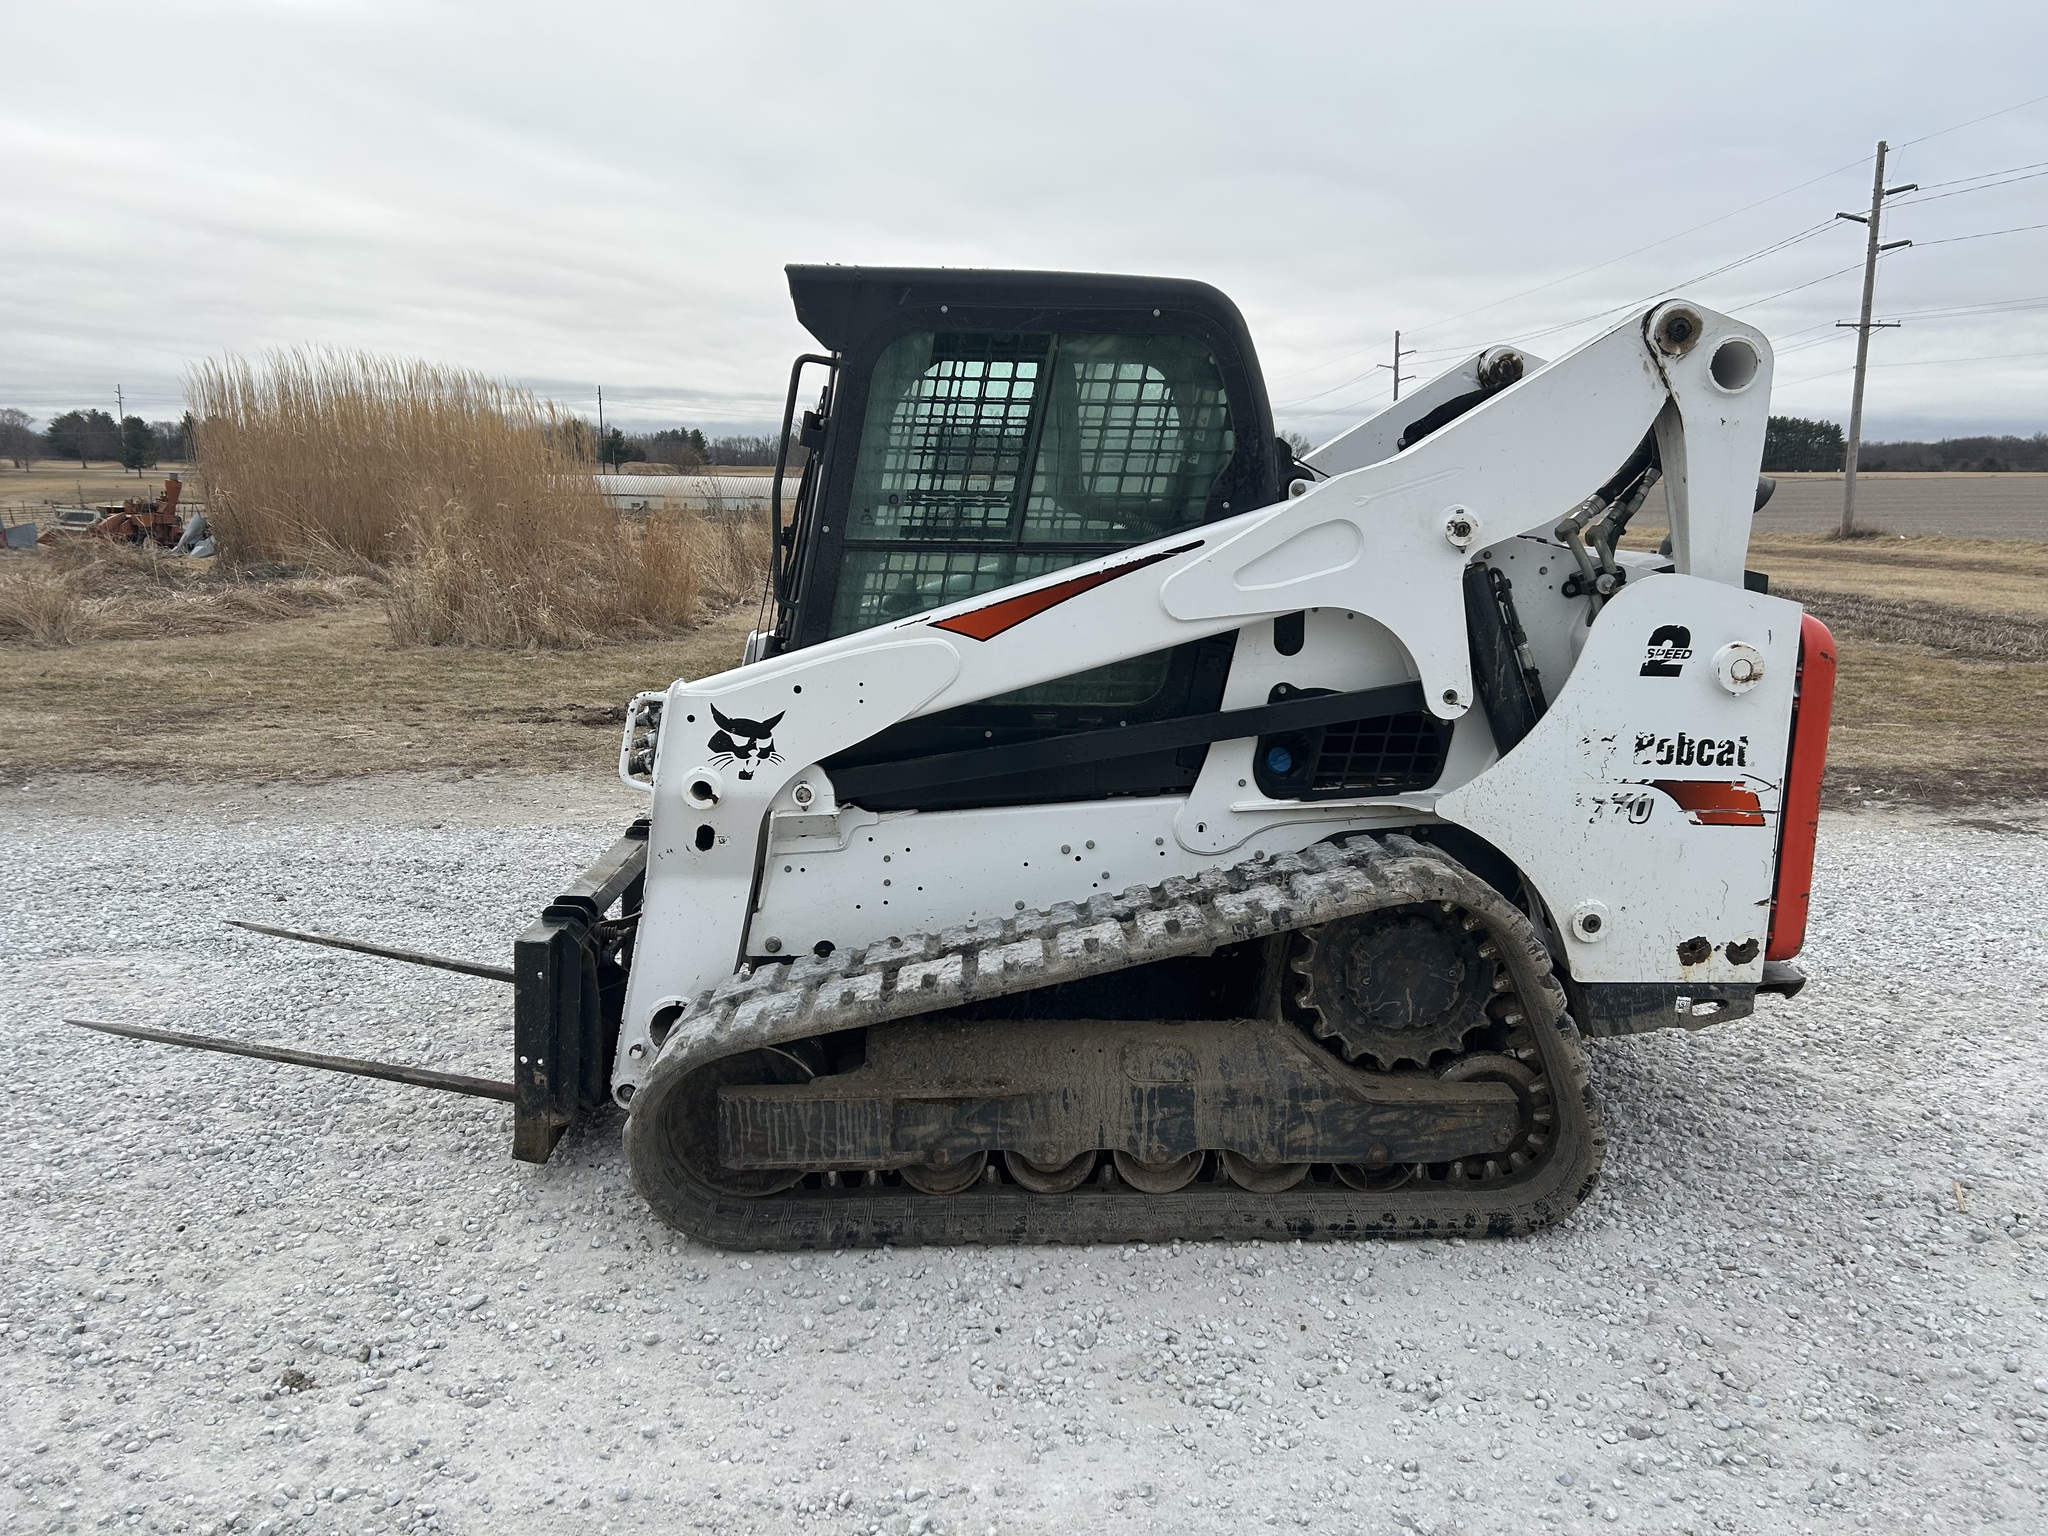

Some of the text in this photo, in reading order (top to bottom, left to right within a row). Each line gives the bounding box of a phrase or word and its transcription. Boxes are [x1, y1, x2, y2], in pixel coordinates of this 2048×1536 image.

[1639, 625, 1691, 677] 2
[1647, 648, 1693, 660] SPEED
[1633, 732, 1749, 767] Bobcat
